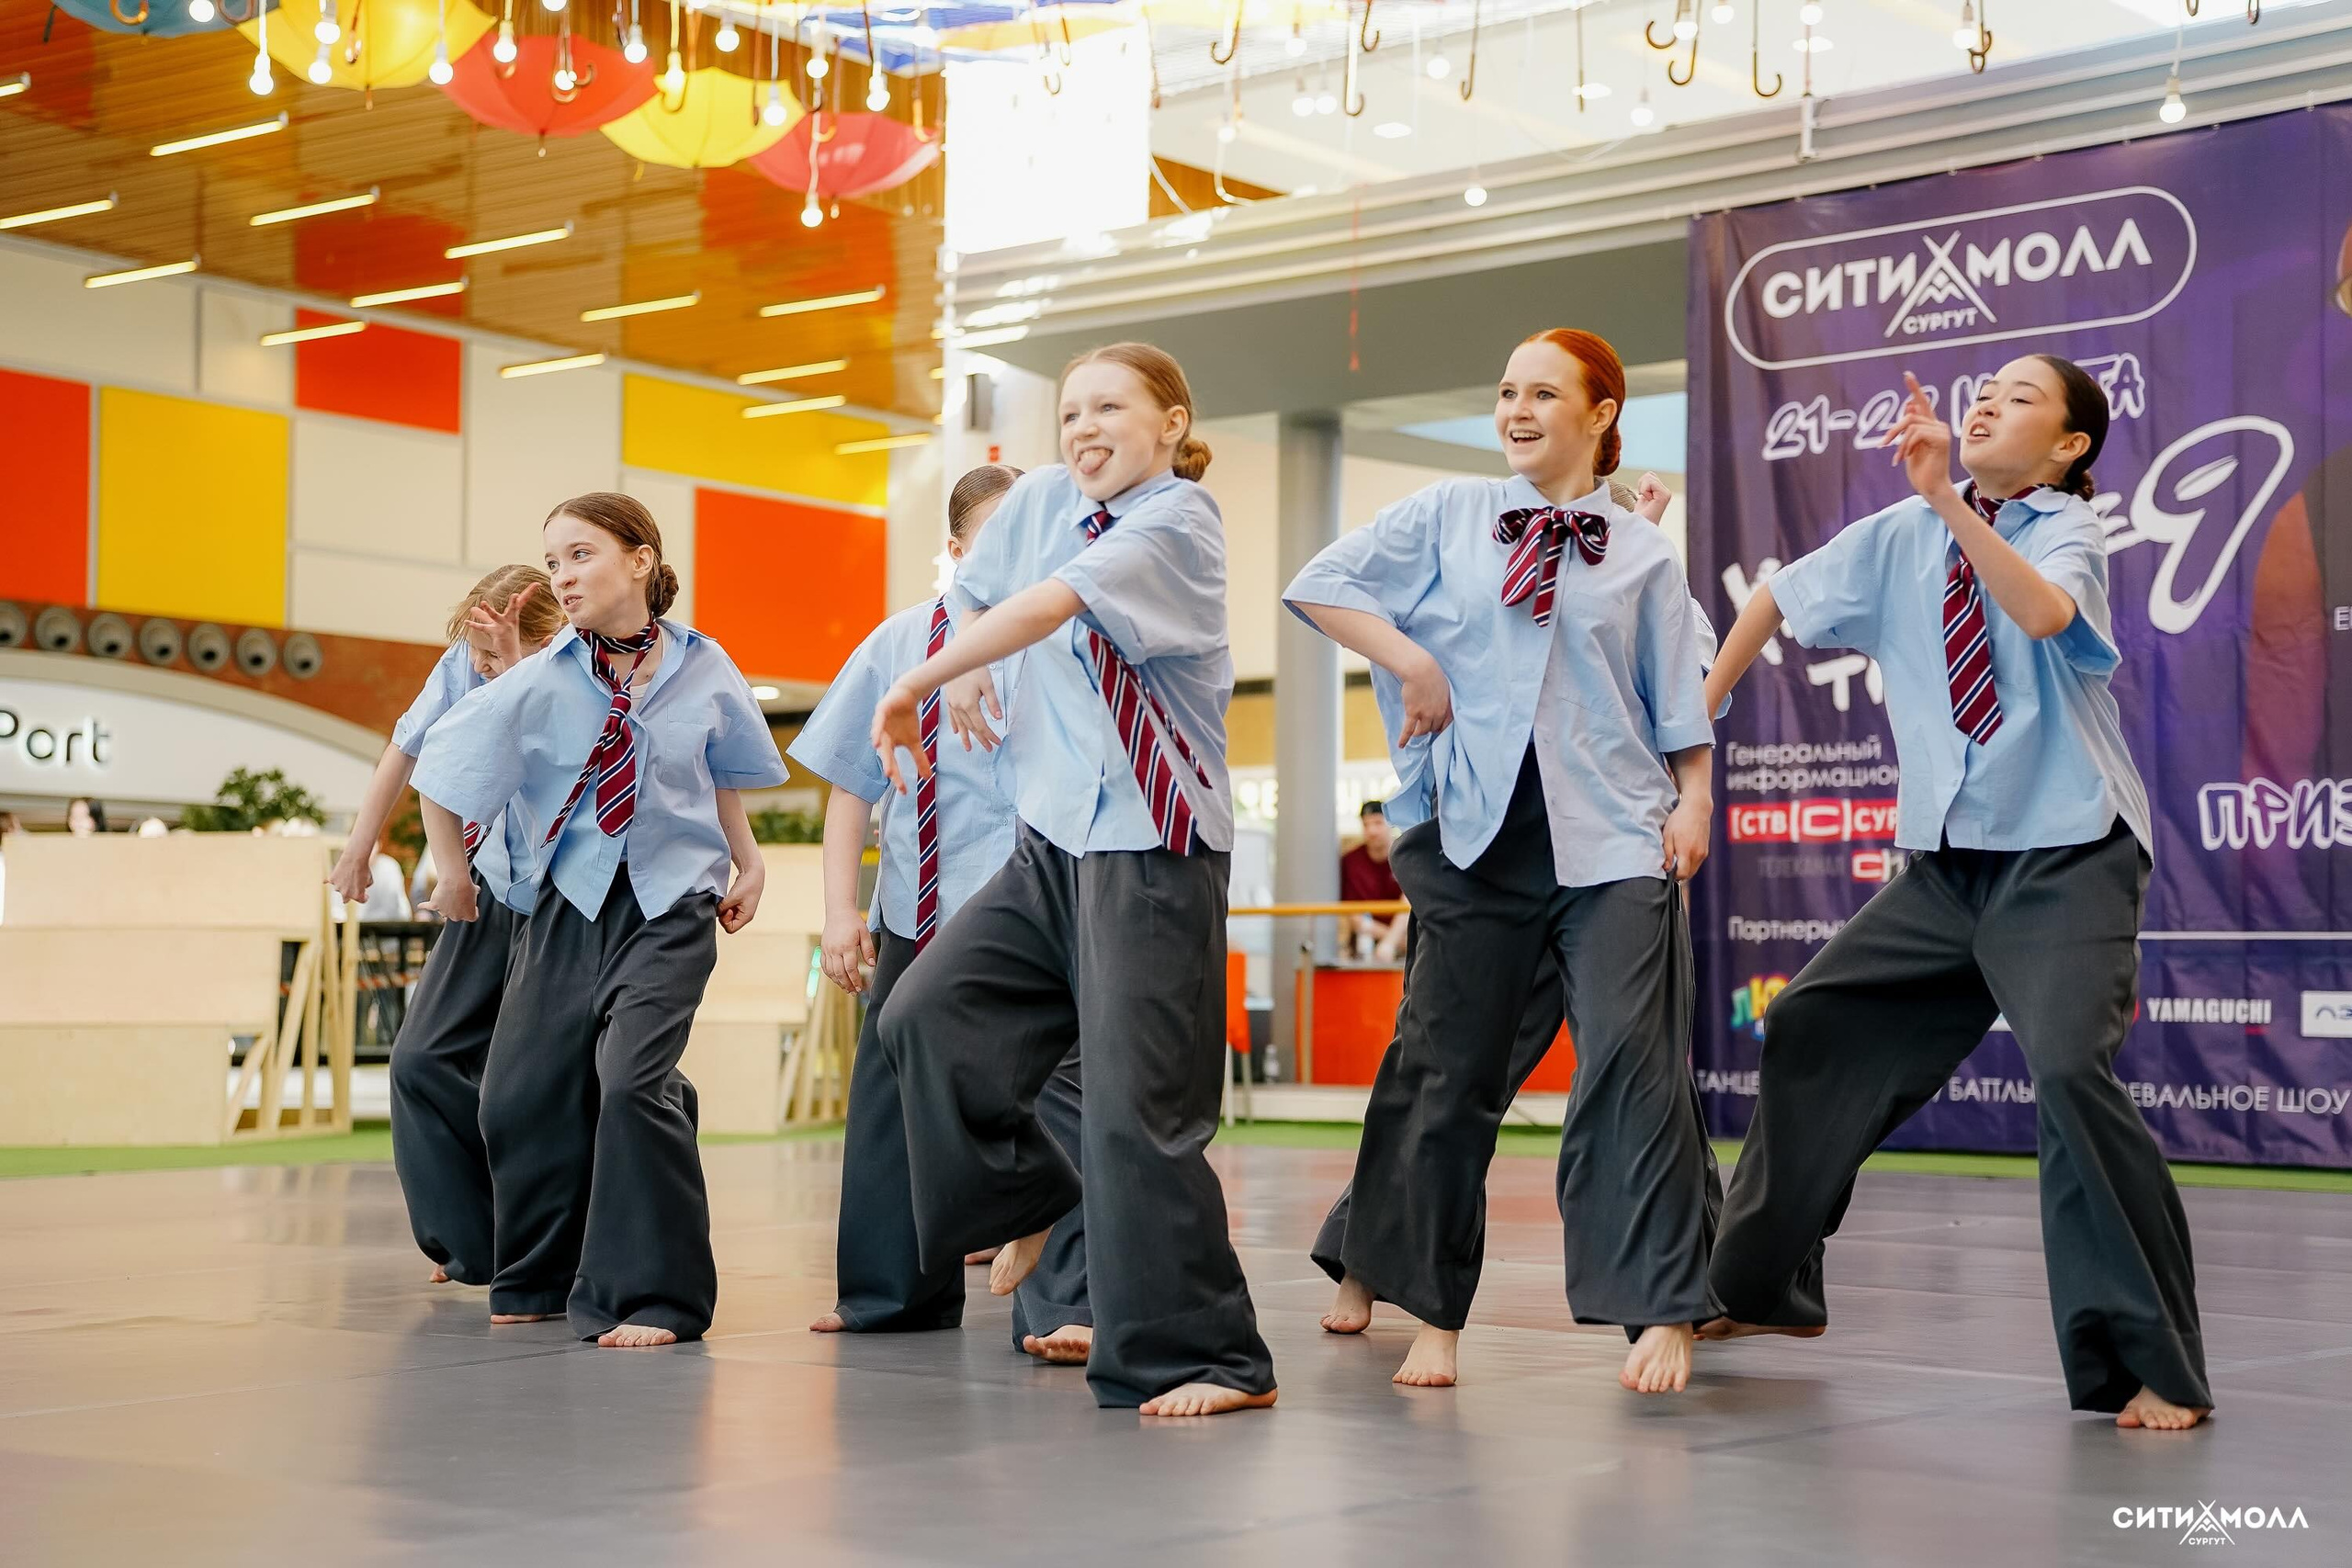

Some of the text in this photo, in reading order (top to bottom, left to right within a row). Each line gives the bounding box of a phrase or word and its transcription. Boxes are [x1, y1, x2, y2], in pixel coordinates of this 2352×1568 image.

[1902, 307, 1979, 335] СУРГУТ
[1726, 734, 1882, 766] Генеральный
[2146, 998, 2272, 1024] YAMAGUCHI
[2125, 1081, 2270, 1111] ЕВАЛЬНОЕ
[2276, 1086, 2352, 1115] ШОУ
